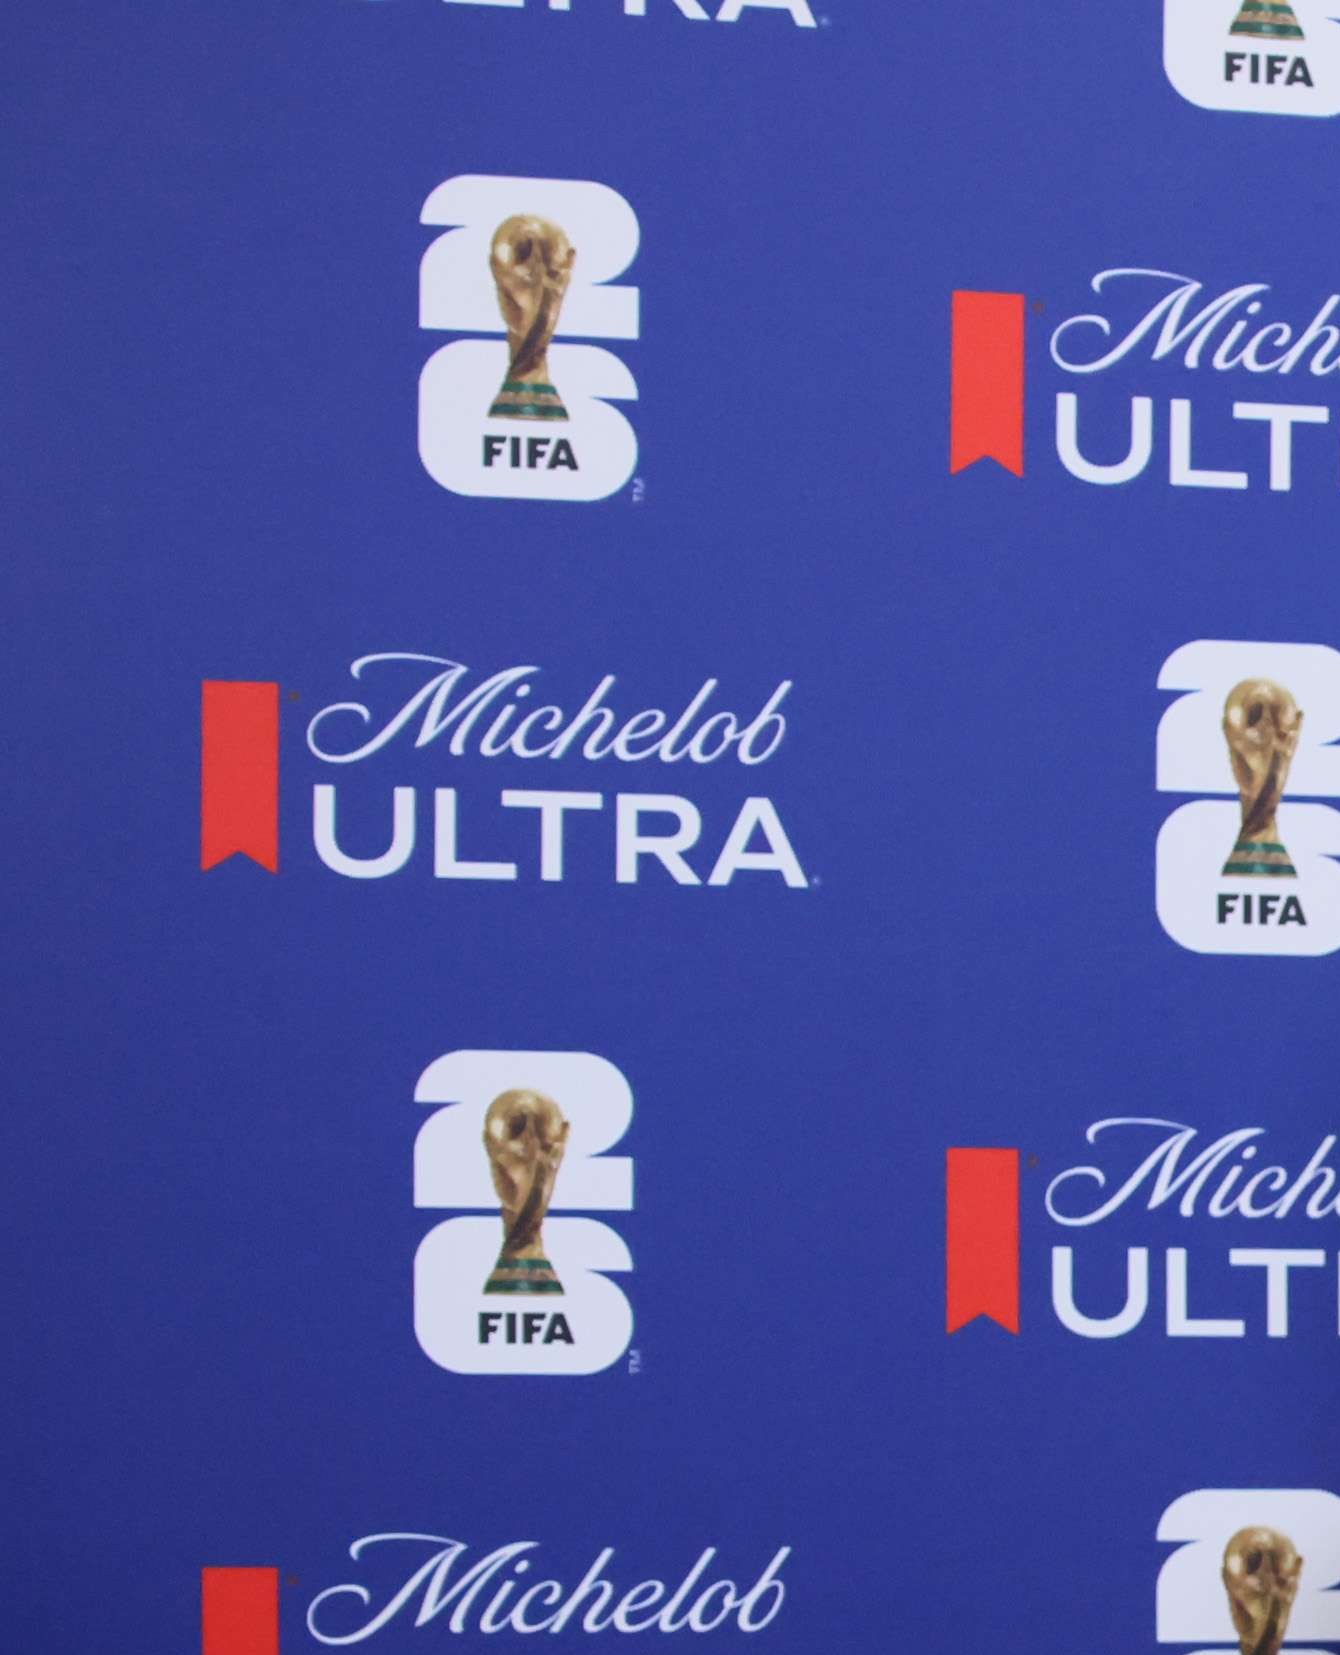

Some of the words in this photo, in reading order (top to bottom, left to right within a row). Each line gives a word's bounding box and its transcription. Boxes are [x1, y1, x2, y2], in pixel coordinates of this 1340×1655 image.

[1225, 52, 1314, 88] FIFA
[483, 435, 579, 471] FIFA
[306, 652, 793, 766] Michelob
[313, 784, 808, 888] ULTRA
[1217, 893, 1307, 926] FIFA
[479, 1312, 574, 1345] FIFA
[306, 1532, 791, 1646] Michelob
